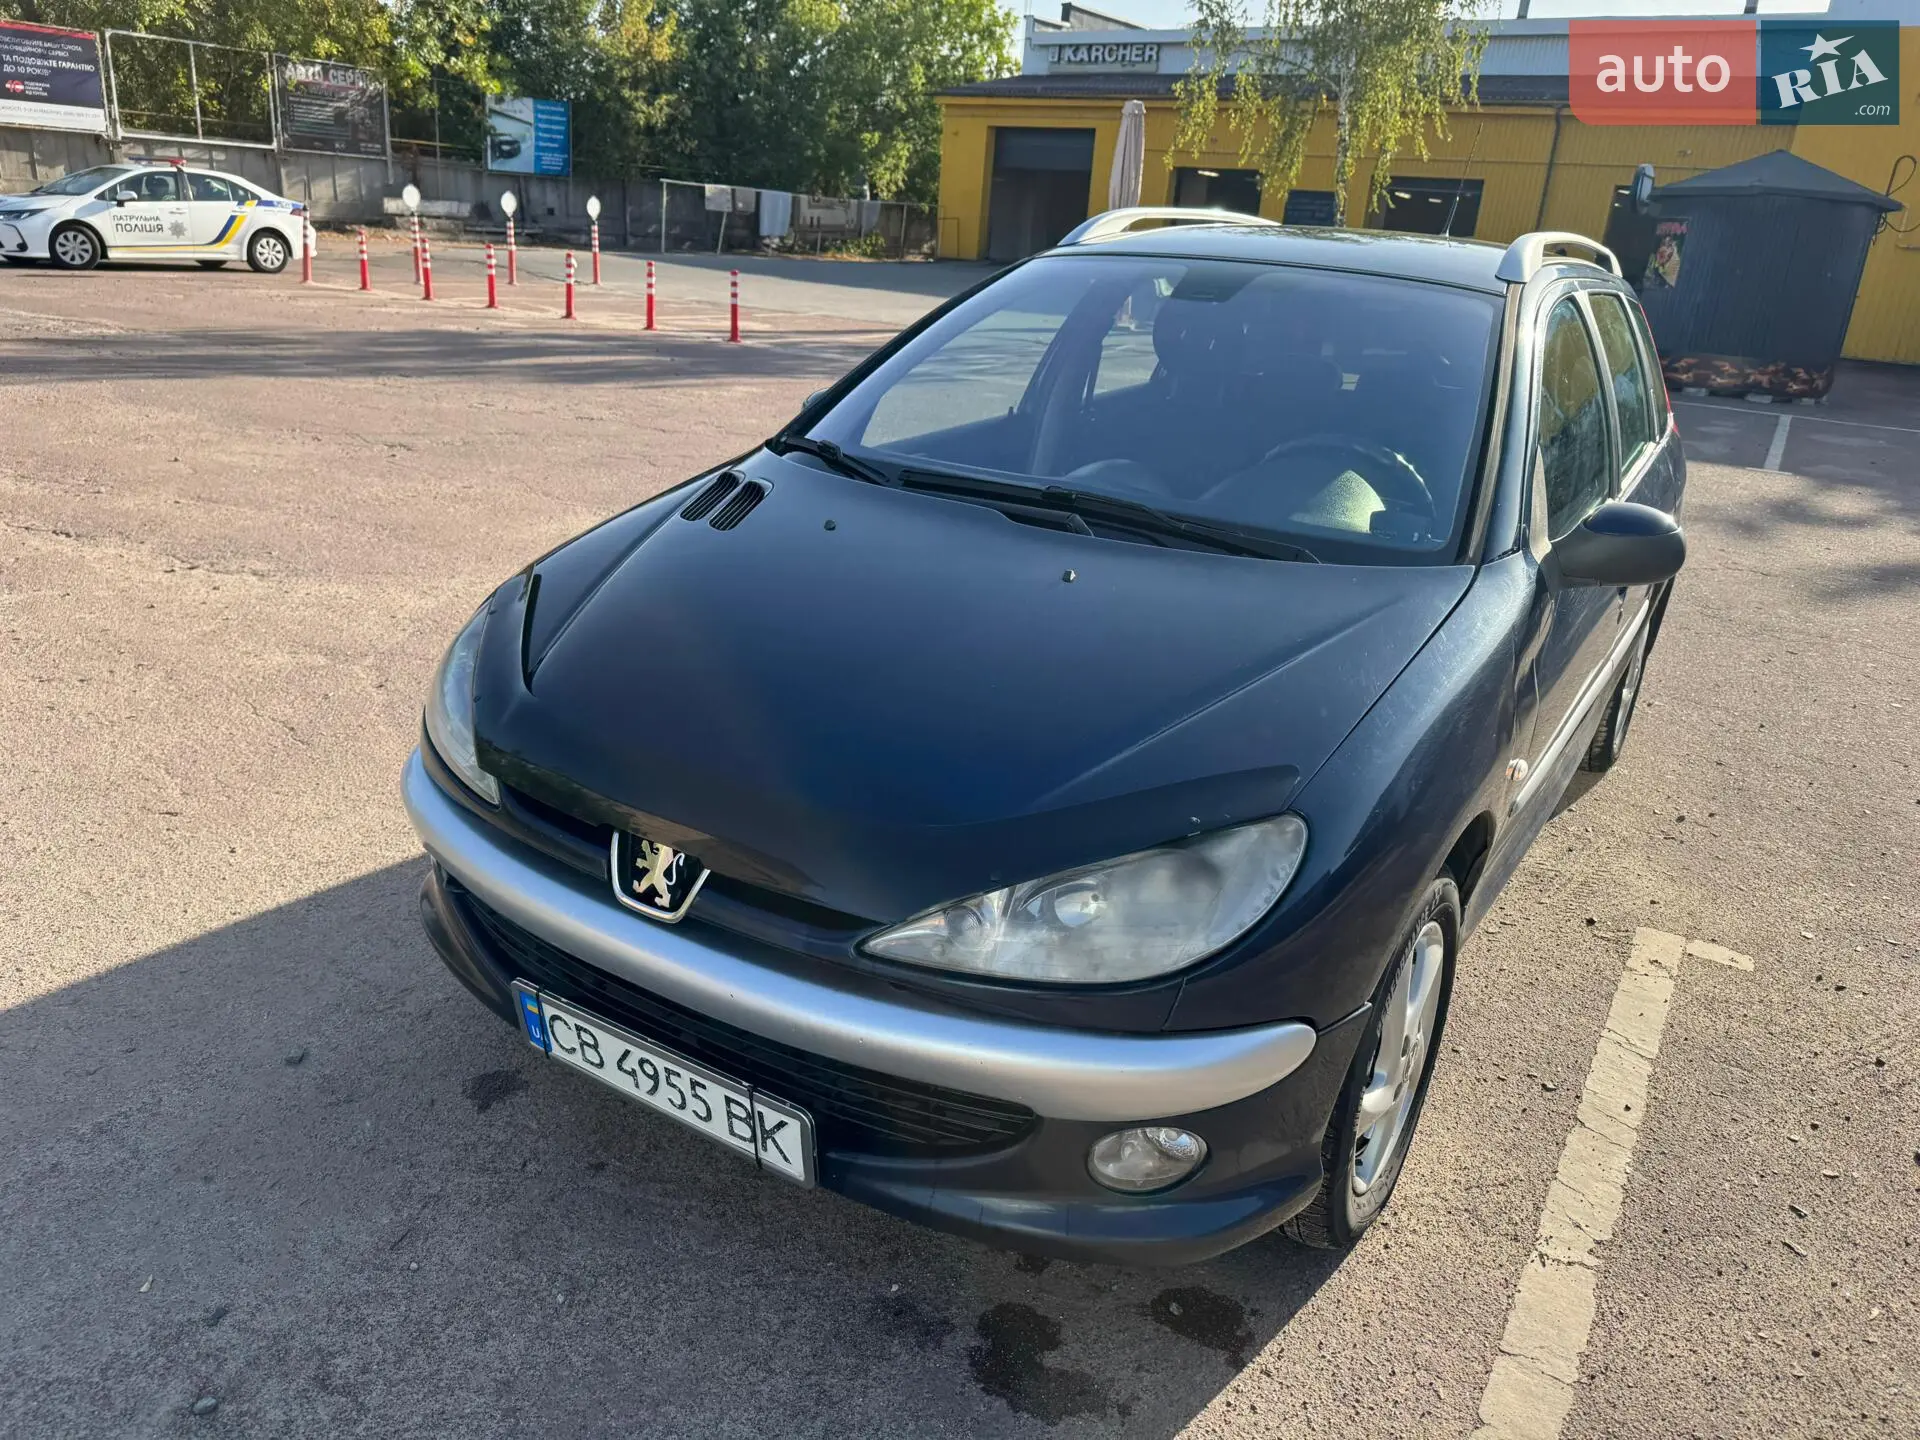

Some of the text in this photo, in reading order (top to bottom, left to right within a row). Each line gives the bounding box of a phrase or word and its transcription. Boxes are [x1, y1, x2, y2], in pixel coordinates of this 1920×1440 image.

[2, 54, 12, 62] ТА
[59, 60, 95, 72] ГАРАНТІЮ
[4, 64, 16, 73] ДО
[17, 66, 25, 74] 10
[113, 214, 161, 222] ПАТРУЛЬНА
[115, 222, 164, 233] ПОЛІЦІЯ
[616, 1048, 713, 1123] 4955
